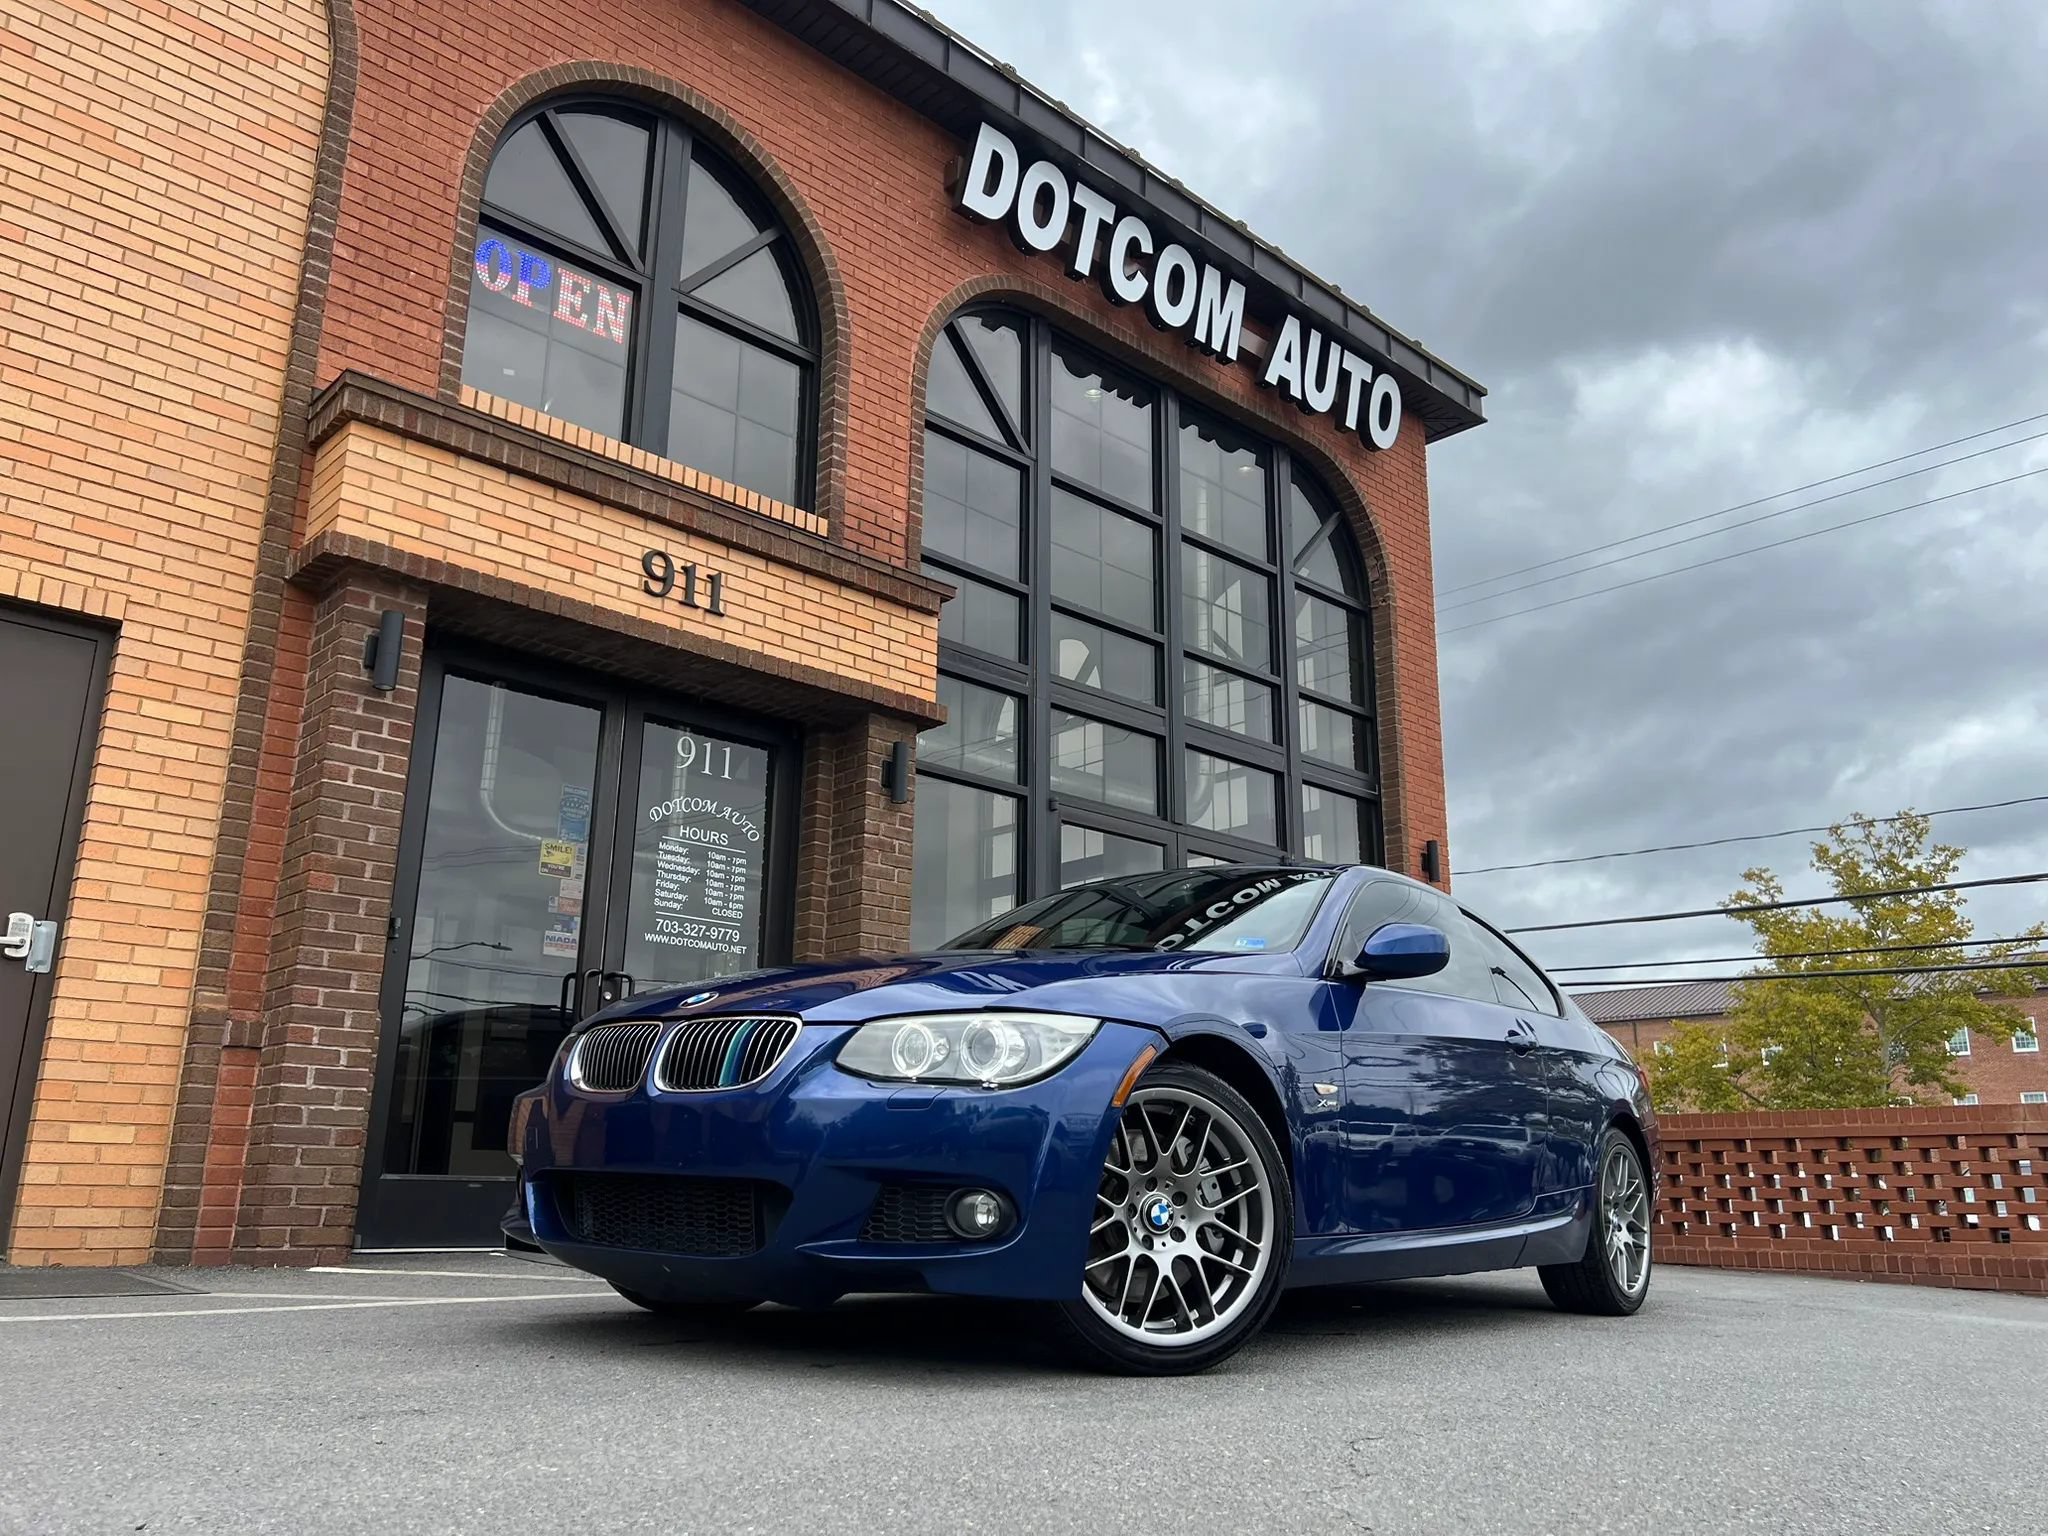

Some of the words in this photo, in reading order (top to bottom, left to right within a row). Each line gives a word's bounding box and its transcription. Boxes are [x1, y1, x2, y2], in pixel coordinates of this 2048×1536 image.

[475, 238, 633, 345] OPEN
[961, 121, 1246, 362] DOTCOM
[1264, 314, 1402, 450] AUTO
[641, 549, 726, 617] 911
[676, 736, 732, 780] 911
[649, 796, 717, 822] DOTCOM
[716, 806, 760, 842] AUTO
[680, 825, 729, 846] HOURS
[544, 842, 573, 855] SMILE!
[708, 851, 727, 861] 10am
[707, 860, 726, 870] 10am
[706, 869, 725, 879] 10am
[705, 878, 724, 888] 10am
[704, 887, 724, 897] 10am
[704, 897, 723, 906] 10am
[711, 907, 743, 919] CLOSED
[655, 918, 740, 942] 703-327-9779
[644, 932, 747, 955] WWW.DOTCOMAUTO.NET
